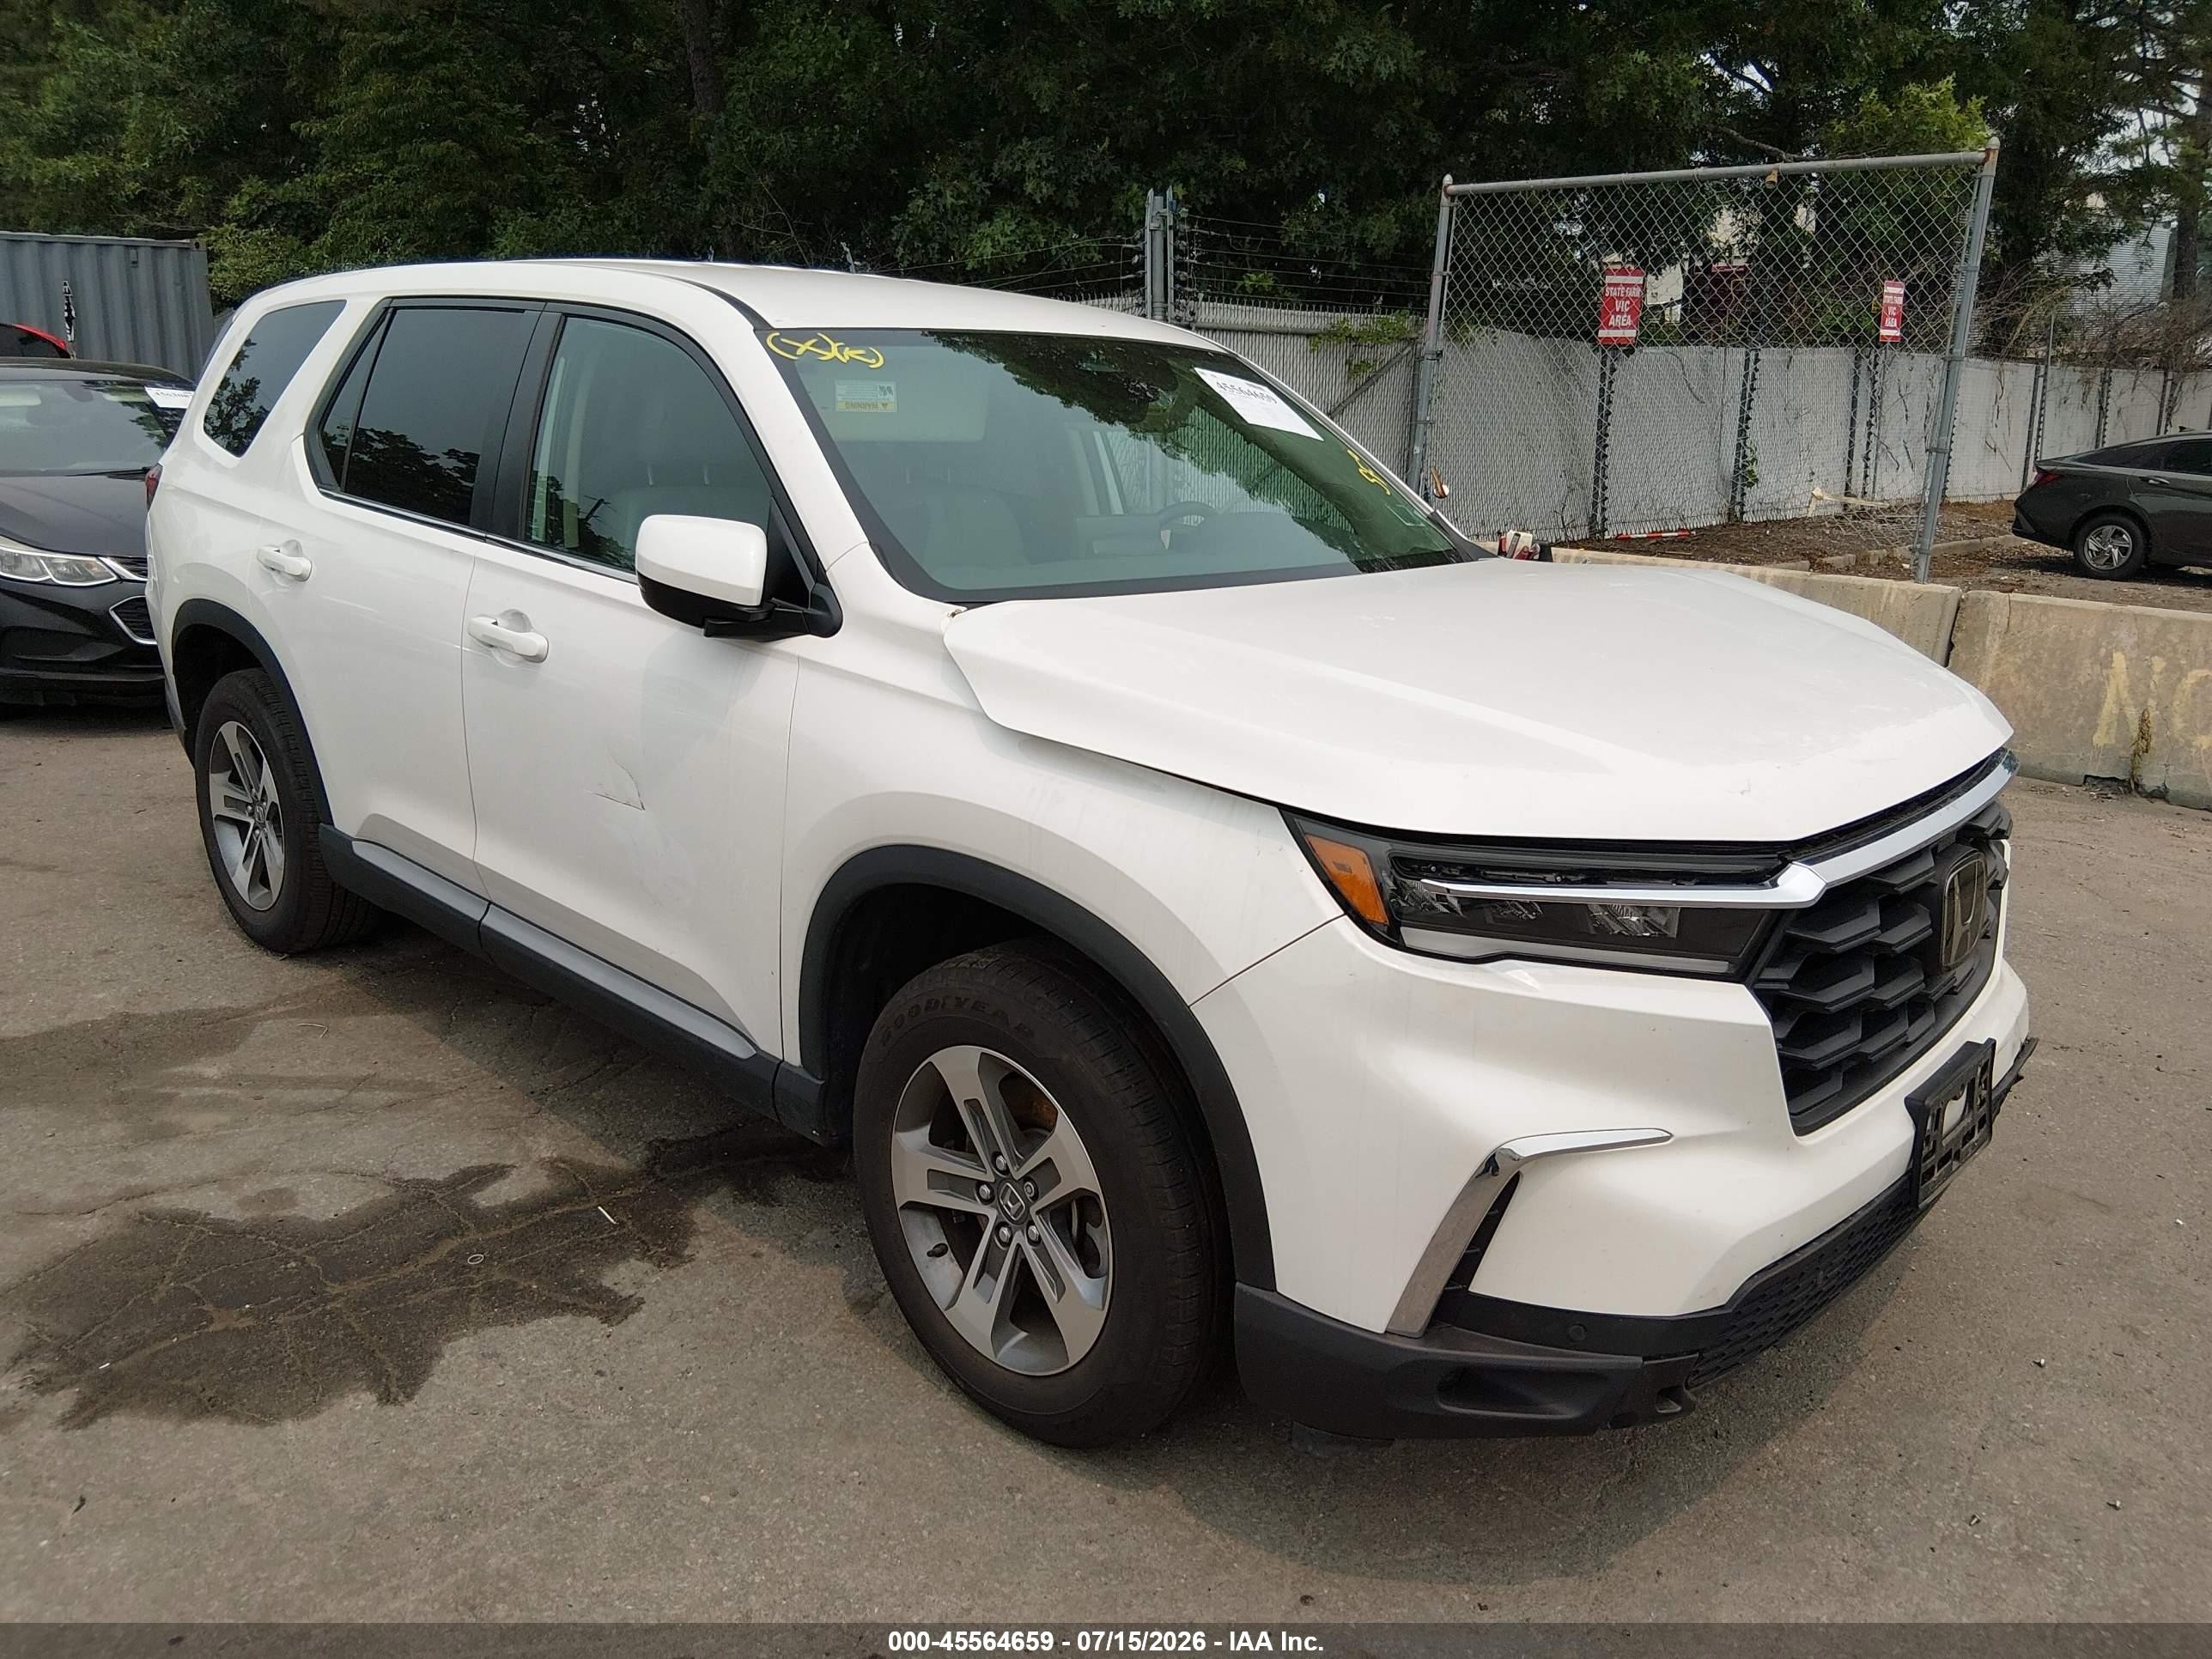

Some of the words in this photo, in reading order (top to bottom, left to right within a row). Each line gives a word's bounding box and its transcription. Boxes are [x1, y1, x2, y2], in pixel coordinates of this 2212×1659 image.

[1605, 287, 1625, 297] STATE
[1615, 300, 1631, 312] VIC
[1887, 306, 1897, 316] VIC
[1608, 314, 1632, 326] AREA
